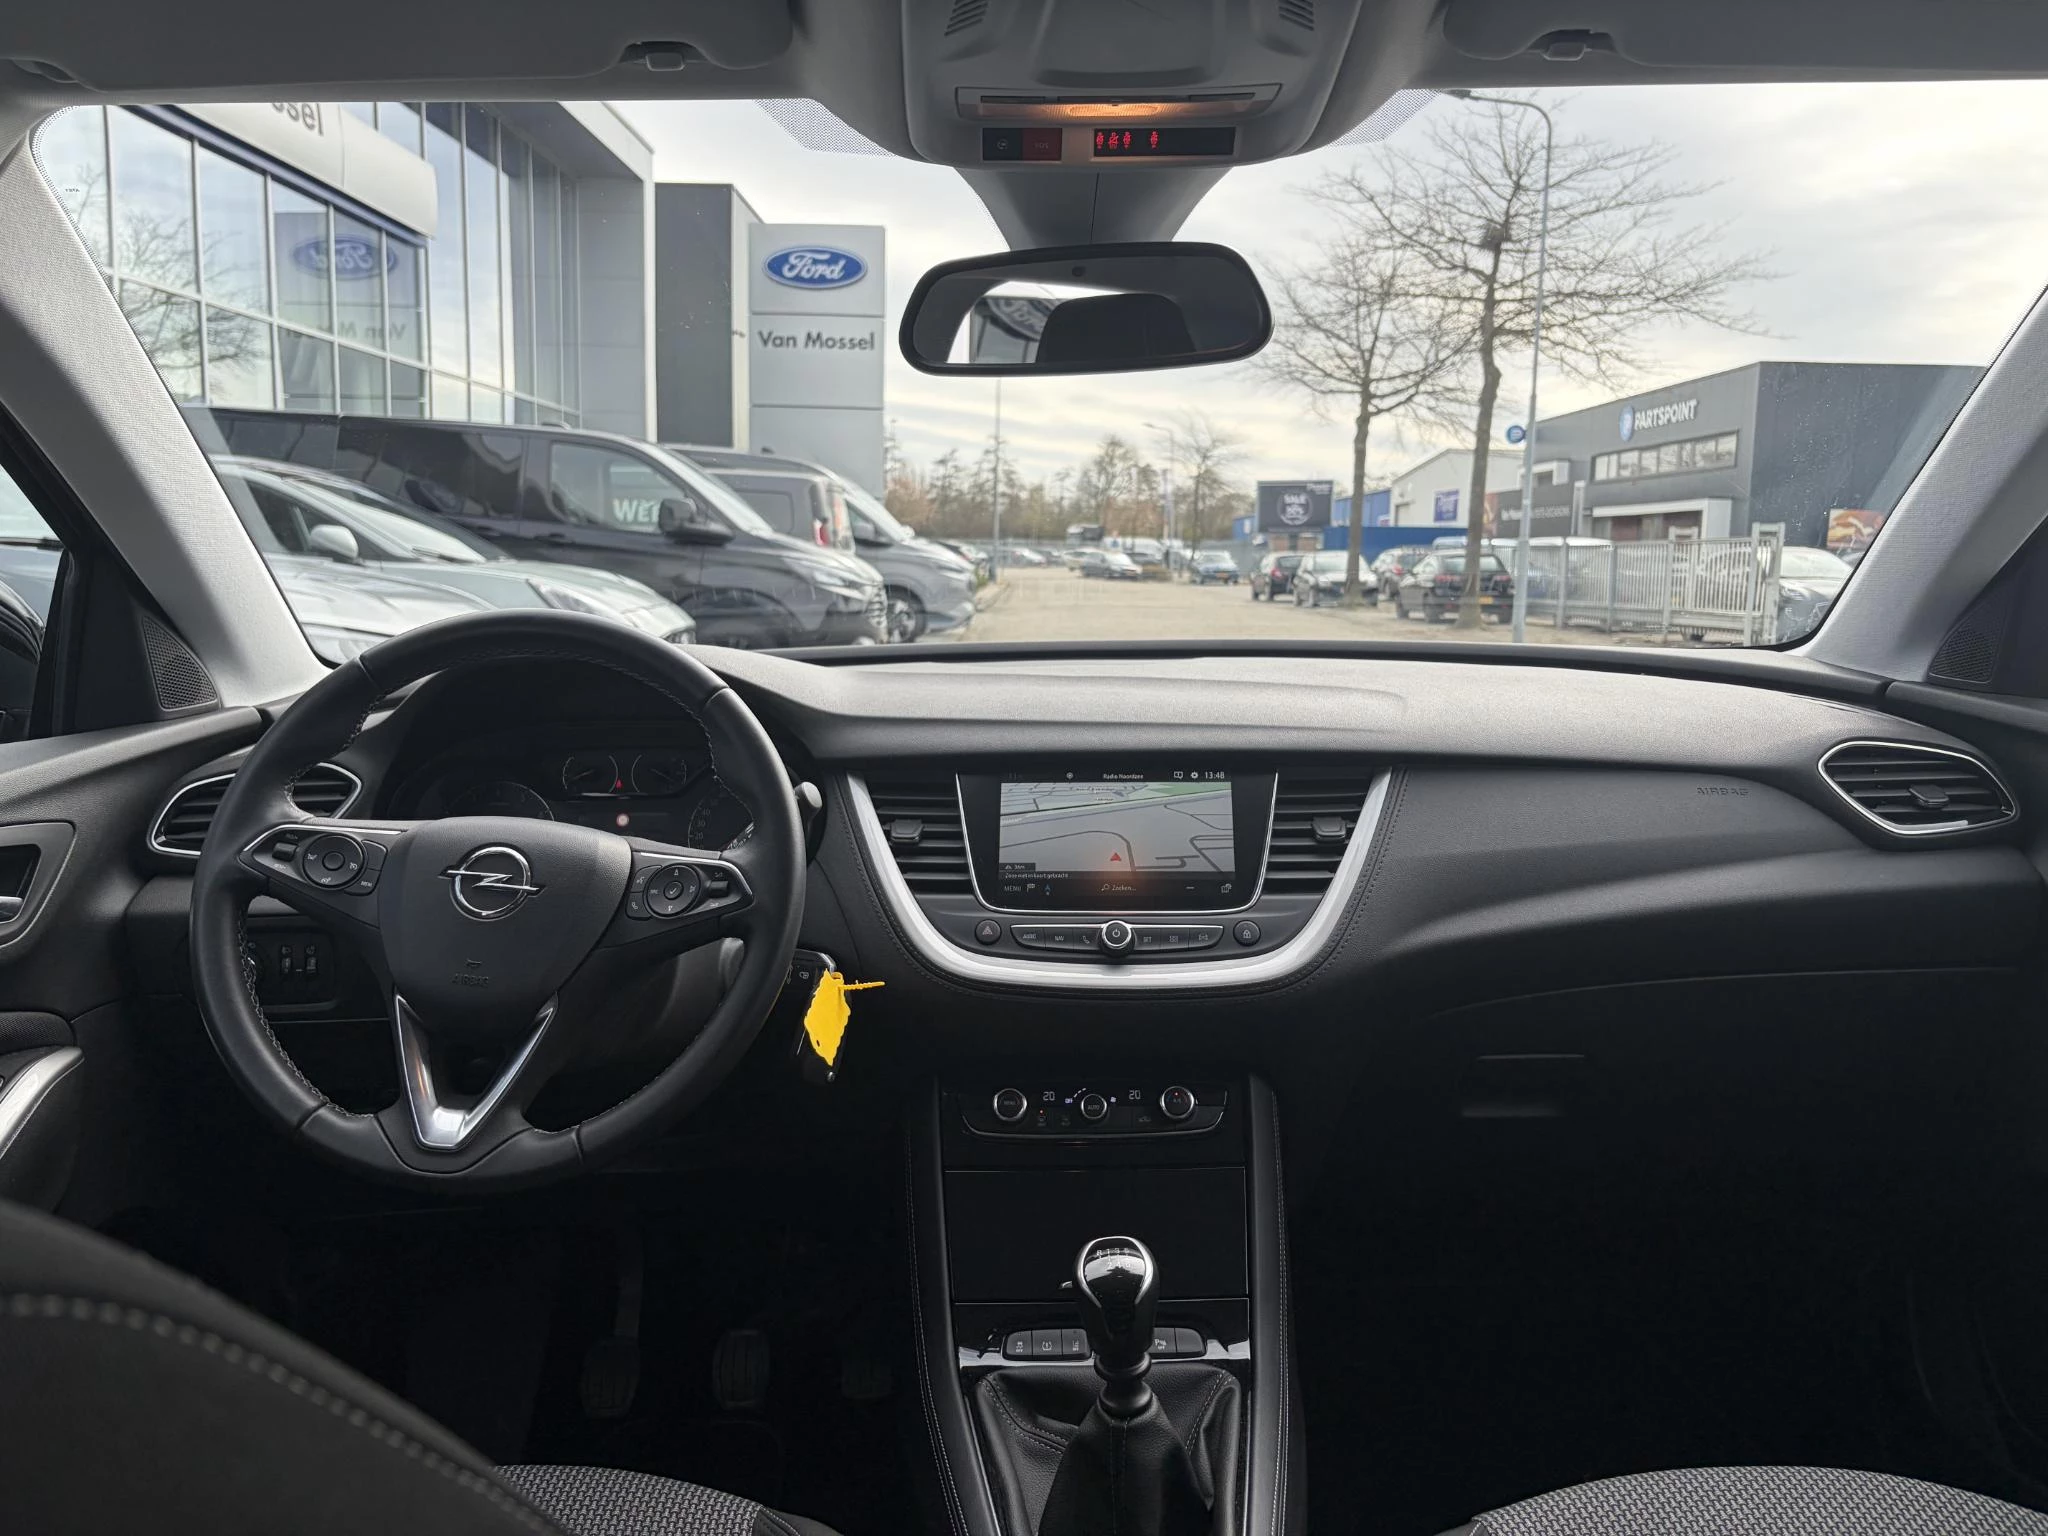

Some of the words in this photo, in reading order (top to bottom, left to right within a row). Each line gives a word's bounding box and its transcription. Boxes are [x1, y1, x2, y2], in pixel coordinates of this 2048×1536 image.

[782, 251, 847, 280] Ford
[758, 330, 798, 350] Van
[804, 331, 876, 351] Mossel
[1634, 398, 1698, 431] PARTSPOINT
[1204, 771, 1225, 779] 13:48
[1004, 884, 1021, 892] MENU
[1042, 1091, 1055, 1101] 20
[1128, 1090, 1141, 1100] 20
